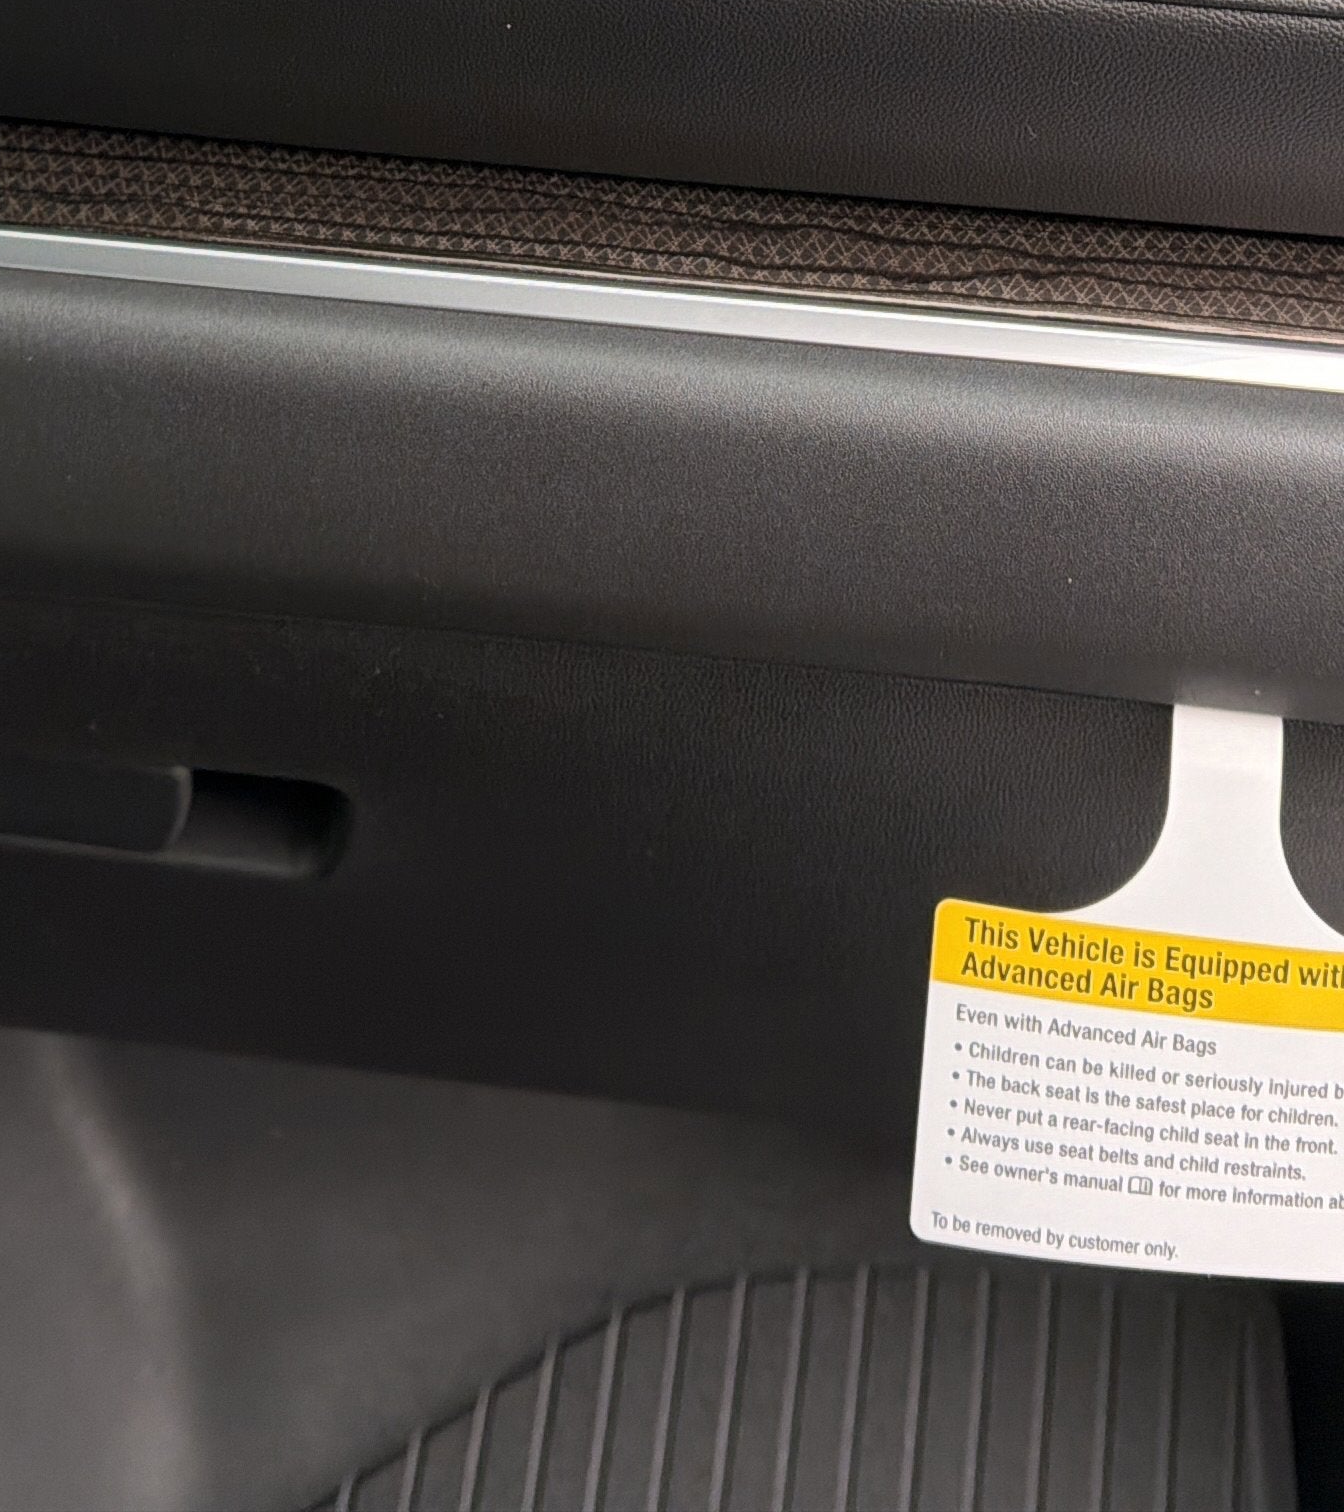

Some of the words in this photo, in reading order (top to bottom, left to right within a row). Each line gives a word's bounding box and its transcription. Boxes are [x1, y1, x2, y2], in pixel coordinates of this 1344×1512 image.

[964, 916, 1019, 950] This
[1028, 928, 1124, 965] Vehicle
[1134, 941, 1155, 968] is
[1165, 946, 1289, 985] Equipped
[961, 951, 1091, 994] Advanced
[1100, 972, 1139, 1000] Air
[1148, 978, 1213, 1013] Bags
[956, 1003, 998, 1027] Even
[1004, 1013, 1042, 1034] with
[1047, 1018, 1136, 1046] Advanced
[1141, 1030, 1167, 1049] Air
[1173, 1034, 1216, 1057] Bags
[967, 1069, 996, 1089] The
[1001, 1075, 1040, 1097] back
[1045, 1085, 1080, 1102] seat
[1086, 1086, 1099, 1104] is
[1105, 1090, 1130, 1108] the
[1136, 1096, 1186, 1114] safest
[1191, 1101, 1235, 1119] place
[1241, 1104, 1264, 1121] for
[1268, 1107, 1338, 1127] children.
[969, 1041, 1040, 1068] Children
[1046, 1056, 1076, 1073] can
[1082, 1058, 1103, 1076] be
[1110, 1061, 1156, 1082] killed
[1162, 1071, 1180, 1085] or
[1185, 1073, 1263, 1097] seriously
[1269, 1078, 1328, 1099] injured
[961, 1126, 1019, 1152] Always
[1025, 1139, 1054, 1155] use
[1059, 1144, 1094, 1161] seat
[1099, 1146, 1138, 1165] belts
[1144, 1154, 1175, 1169] and
[1179, 1156, 1219, 1173] child
[1224, 1161, 1305, 1180] restraints.
[964, 1098, 1012, 1120] Never
[1016, 1110, 1043, 1126] put
[1048, 1114, 1057, 1127] a
[1063, 1116, 1154, 1143] rear-facing
[1160, 1125, 1199, 1143] child
[1204, 1132, 1239, 1147] seat
[1244, 1132, 1259, 1149] in
[1265, 1135, 1290, 1151] the
[1296, 1137, 1337, 1154] front.
[959, 1155, 989, 1174] See
[994, 1164, 1058, 1184] owner's
[1064, 1173, 1123, 1192] manual
[1159, 1181, 1181, 1198] for
[1186, 1187, 1227, 1202] more
[1233, 1187, 1323, 1209] information
[932, 1211, 948, 1229] To
[953, 1215, 970, 1233] be
[976, 1222, 1041, 1243] removed
[1046, 1229, 1064, 1249] by
[1069, 1235, 1140, 1254] customer
[1144, 1242, 1177, 1259] only.
